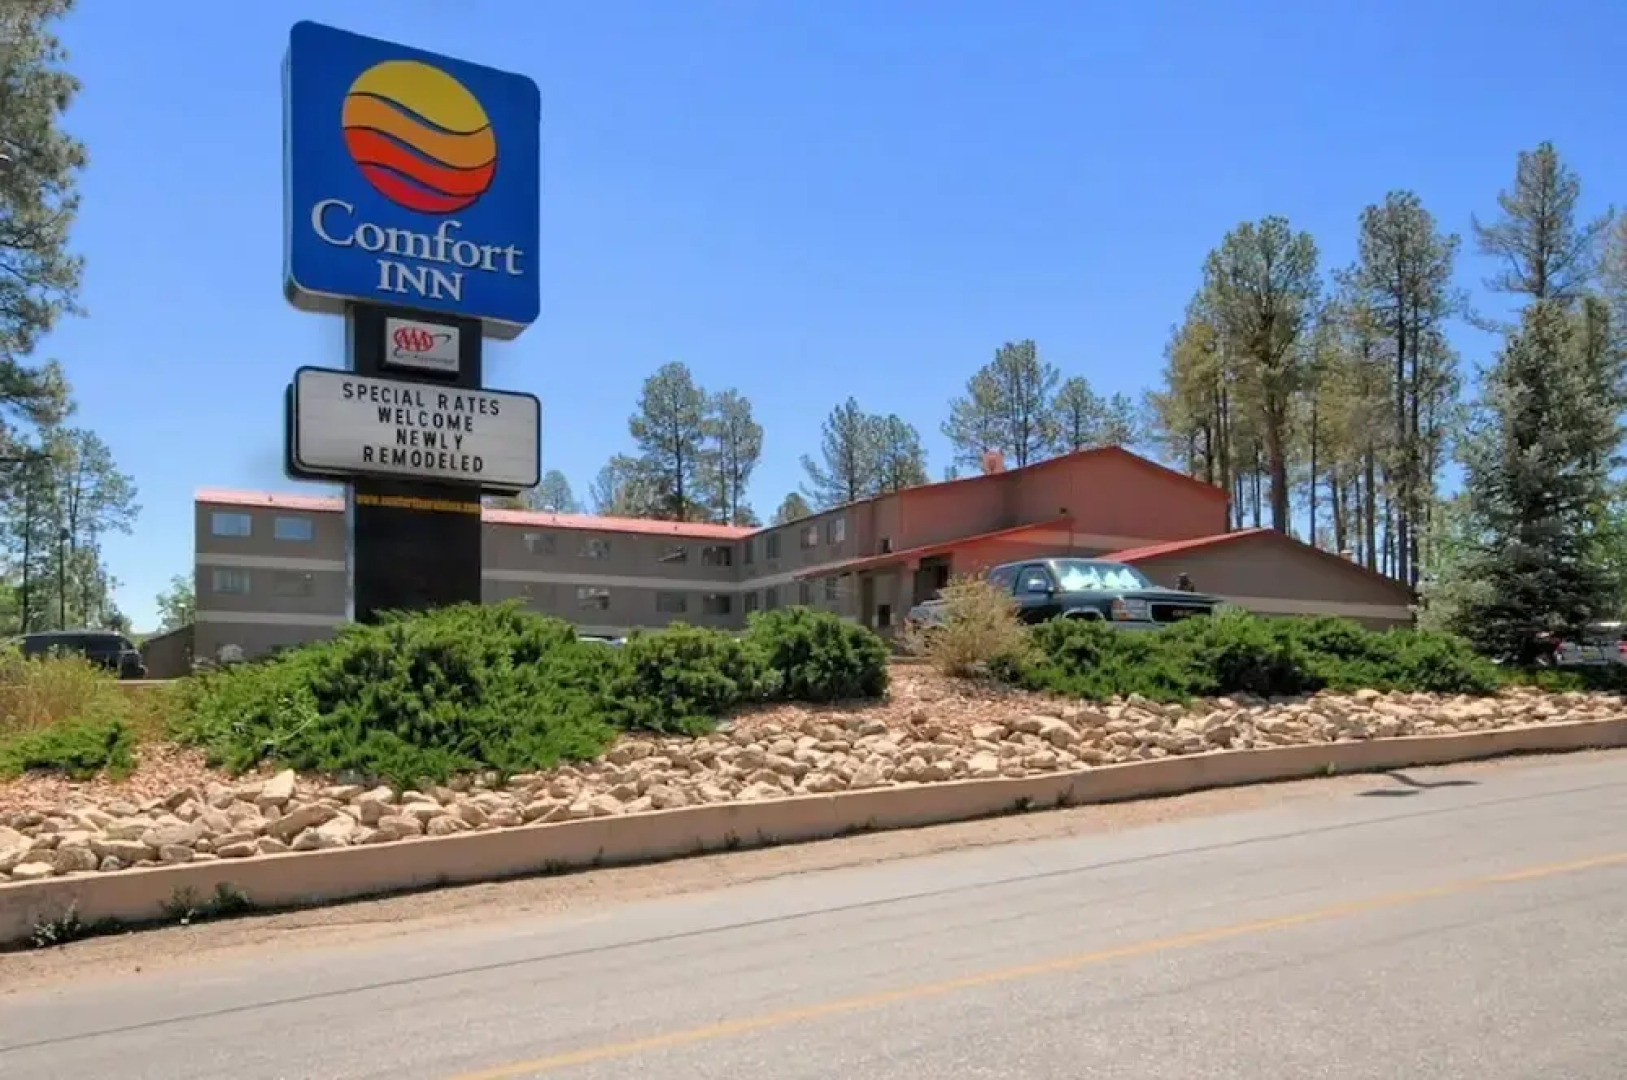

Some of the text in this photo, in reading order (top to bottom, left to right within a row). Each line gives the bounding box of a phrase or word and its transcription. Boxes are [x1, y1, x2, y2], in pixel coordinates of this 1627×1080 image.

[311, 199, 523, 274] Comfort
[376, 259, 463, 300] INN
[394, 326, 433, 351] AAA
[343, 383, 499, 415] SPECIAL RATES
[378, 407, 473, 431] WELCOME
[397, 429, 463, 450] NEWLY
[363, 446, 483, 472] REMODELED
